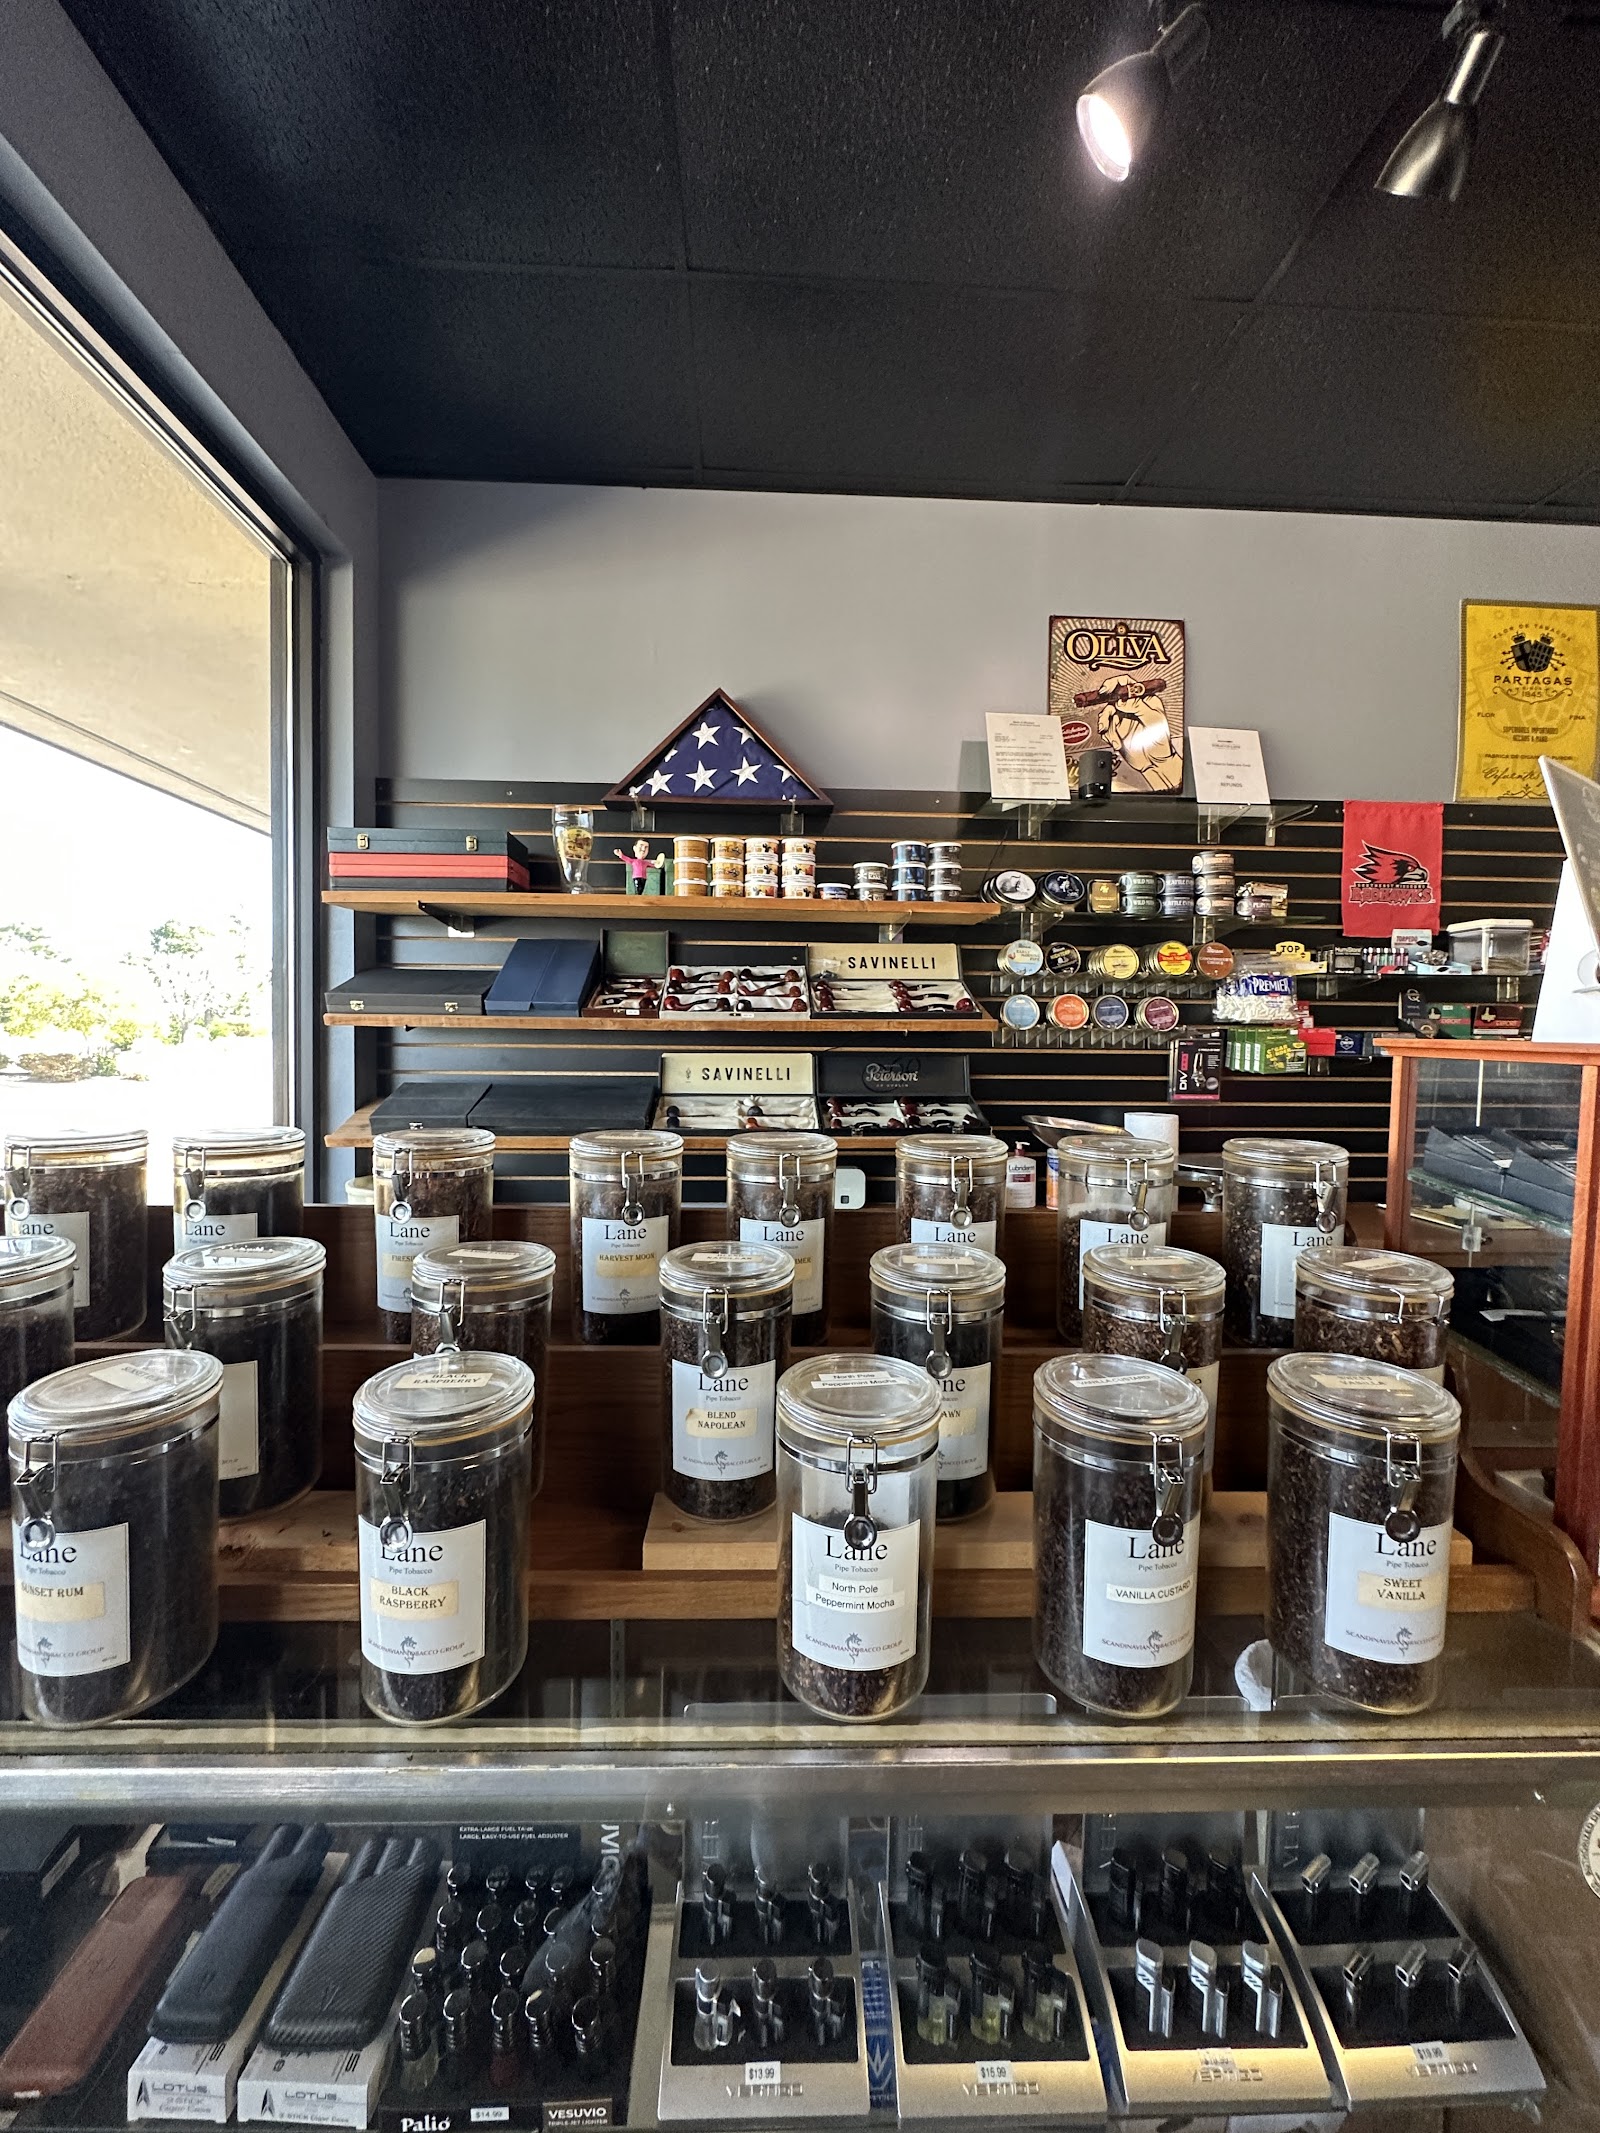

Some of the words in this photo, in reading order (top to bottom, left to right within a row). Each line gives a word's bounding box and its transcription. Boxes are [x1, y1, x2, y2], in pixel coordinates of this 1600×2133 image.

[1066, 631, 1168, 662] OLIVA
[1493, 675, 1573, 686] PARTAGAS
[1521, 690, 1543, 698] 1845
[1477, 711, 1496, 719] FLOR
[1351, 887, 1432, 902] REDHAWKS
[1280, 945, 1300, 953] TOP
[848, 956, 935, 969] SAVINELLI
[1252, 977, 1290, 993] PREMIER
[702, 1067, 791, 1081] SAVINELLI
[865, 1063, 919, 1082] Peterson
[184, 1220, 226, 1237] Lane
[389, 1221, 431, 1239] Lane
[604, 1224, 647, 1242] Lane
[763, 1225, 805, 1242] Lane
[935, 1226, 977, 1243] Lane
[1106, 1227, 1149, 1245] Lane
[1293, 1231, 1333, 1248] Lane
[610, 1243, 622, 1251] Pipe
[599, 1254, 634, 1262] HARVEST
[635, 1252, 656, 1261] MOON
[697, 1372, 749, 1392] Lane
[1108, 1374, 1150, 1383] CUSTARD
[707, 1411, 736, 1419] BLEND
[942, 1410, 961, 1418] AWN
[697, 1420, 746, 1429] NAPOLEAN
[1374, 1531, 1437, 1557] Lane
[380, 1544, 444, 1563] Lane
[37, 1566, 66, 1576] Tobacco
[388, 1565, 403, 1575] Pipe
[404, 1566, 433, 1575] Tobacco
[834, 1563, 850, 1573] Pipe
[850, 1565, 879, 1573] Tobacco
[1137, 1563, 1151, 1572] Pipe
[1153, 1561, 1178, 1571] Tobacco
[1386, 1560, 1402, 1569] Pipe
[1403, 1560, 1430, 1568] Tobacco
[831, 1582, 856, 1594] North
[858, 1584, 879, 1594] Pole
[1383, 1577, 1422, 1588] SWEET
[20, 1583, 54, 1598] SUNSET
[57, 1585, 84, 1598] RUM
[391, 1584, 430, 1597] BLACK
[1115, 1588, 1155, 1600] VANILLA
[1157, 1579, 1191, 1598] CUSTARD
[1376, 1589, 1426, 1601] VANILLA
[379, 1594, 447, 1610] RASPBERRY
[815, 1593, 865, 1611] Peppermint
[866, 1598, 895, 1610] Mocha
[439, 1641, 466, 1655] GROUP
[882, 1639, 903, 1652] GROUP
[749, 2067, 775, 2080] $13.99
[152, 2081, 208, 2094] LOTUS
[285, 2090, 337, 2101] LOTUS
[476, 2110, 503, 2119] $14.99
[548, 2107, 607, 2119] VESUVIO
